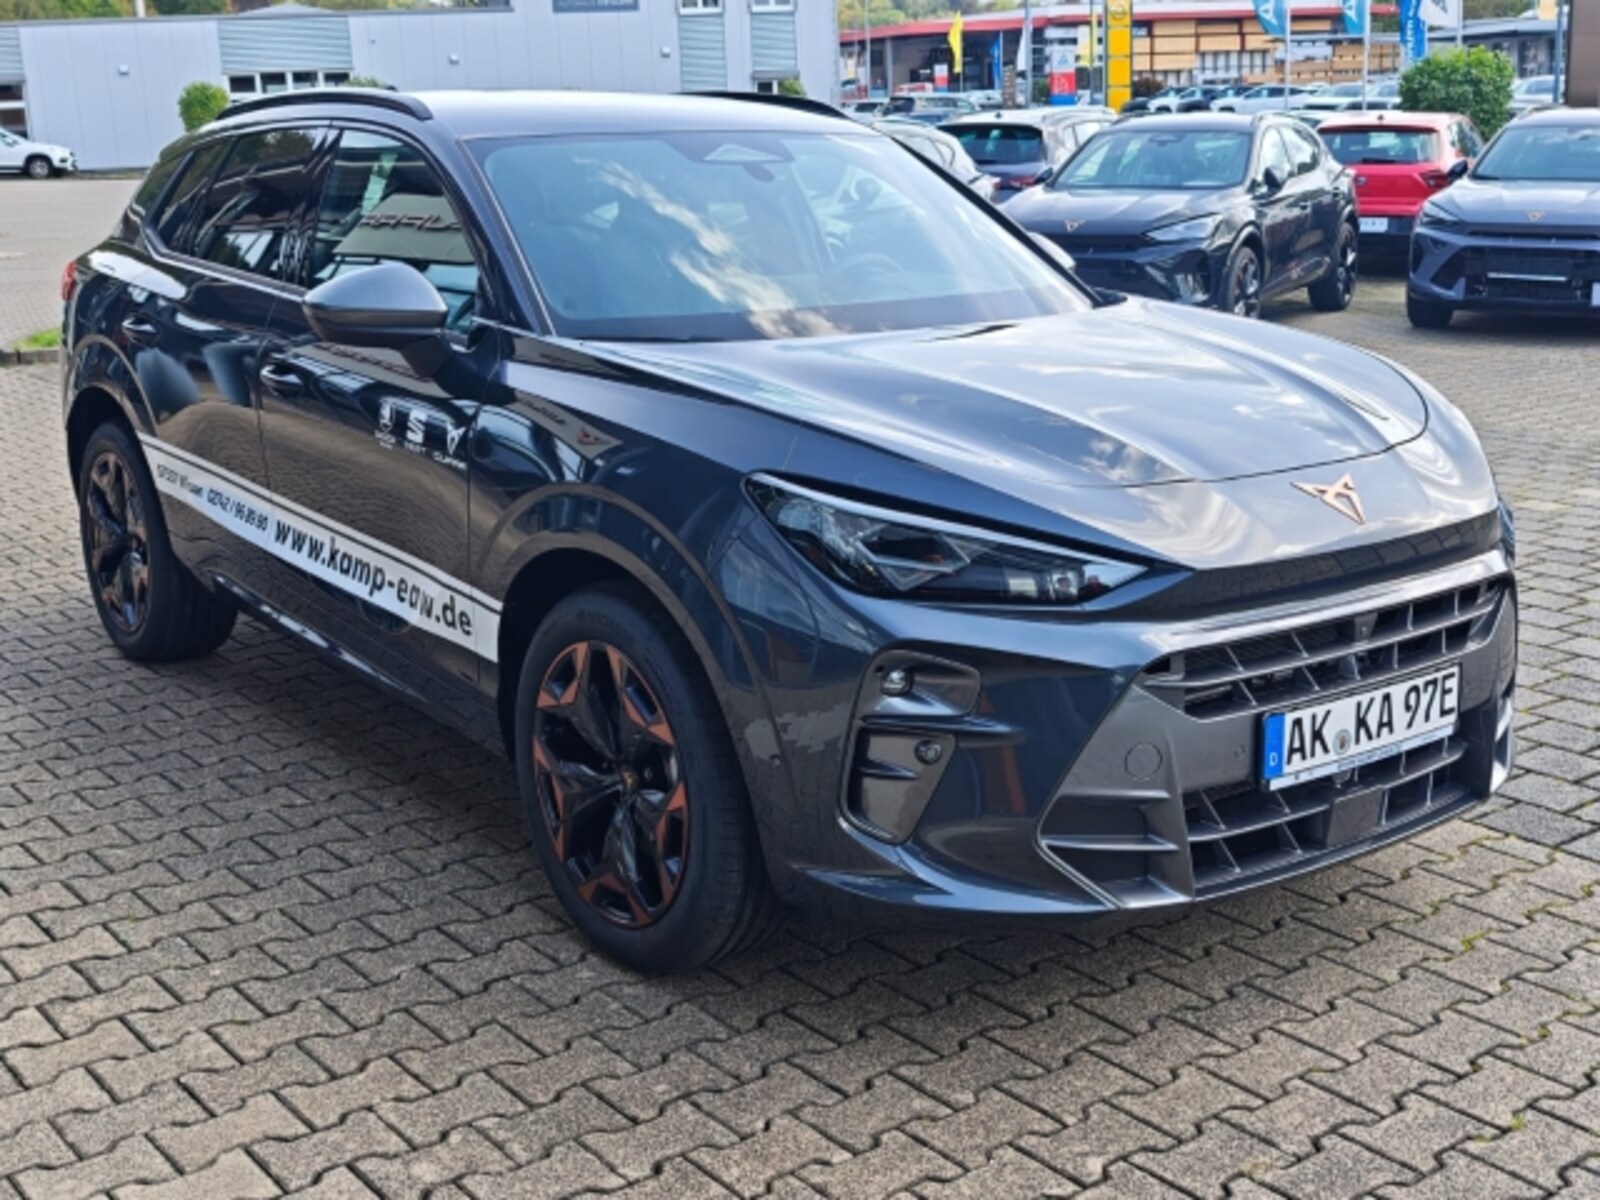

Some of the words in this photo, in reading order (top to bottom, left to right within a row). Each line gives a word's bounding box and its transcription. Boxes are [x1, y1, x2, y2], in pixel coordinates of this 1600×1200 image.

[1286, 709, 1332, 766] AK
[1354, 691, 1395, 746] KA
[1404, 671, 1457, 730] 97E
